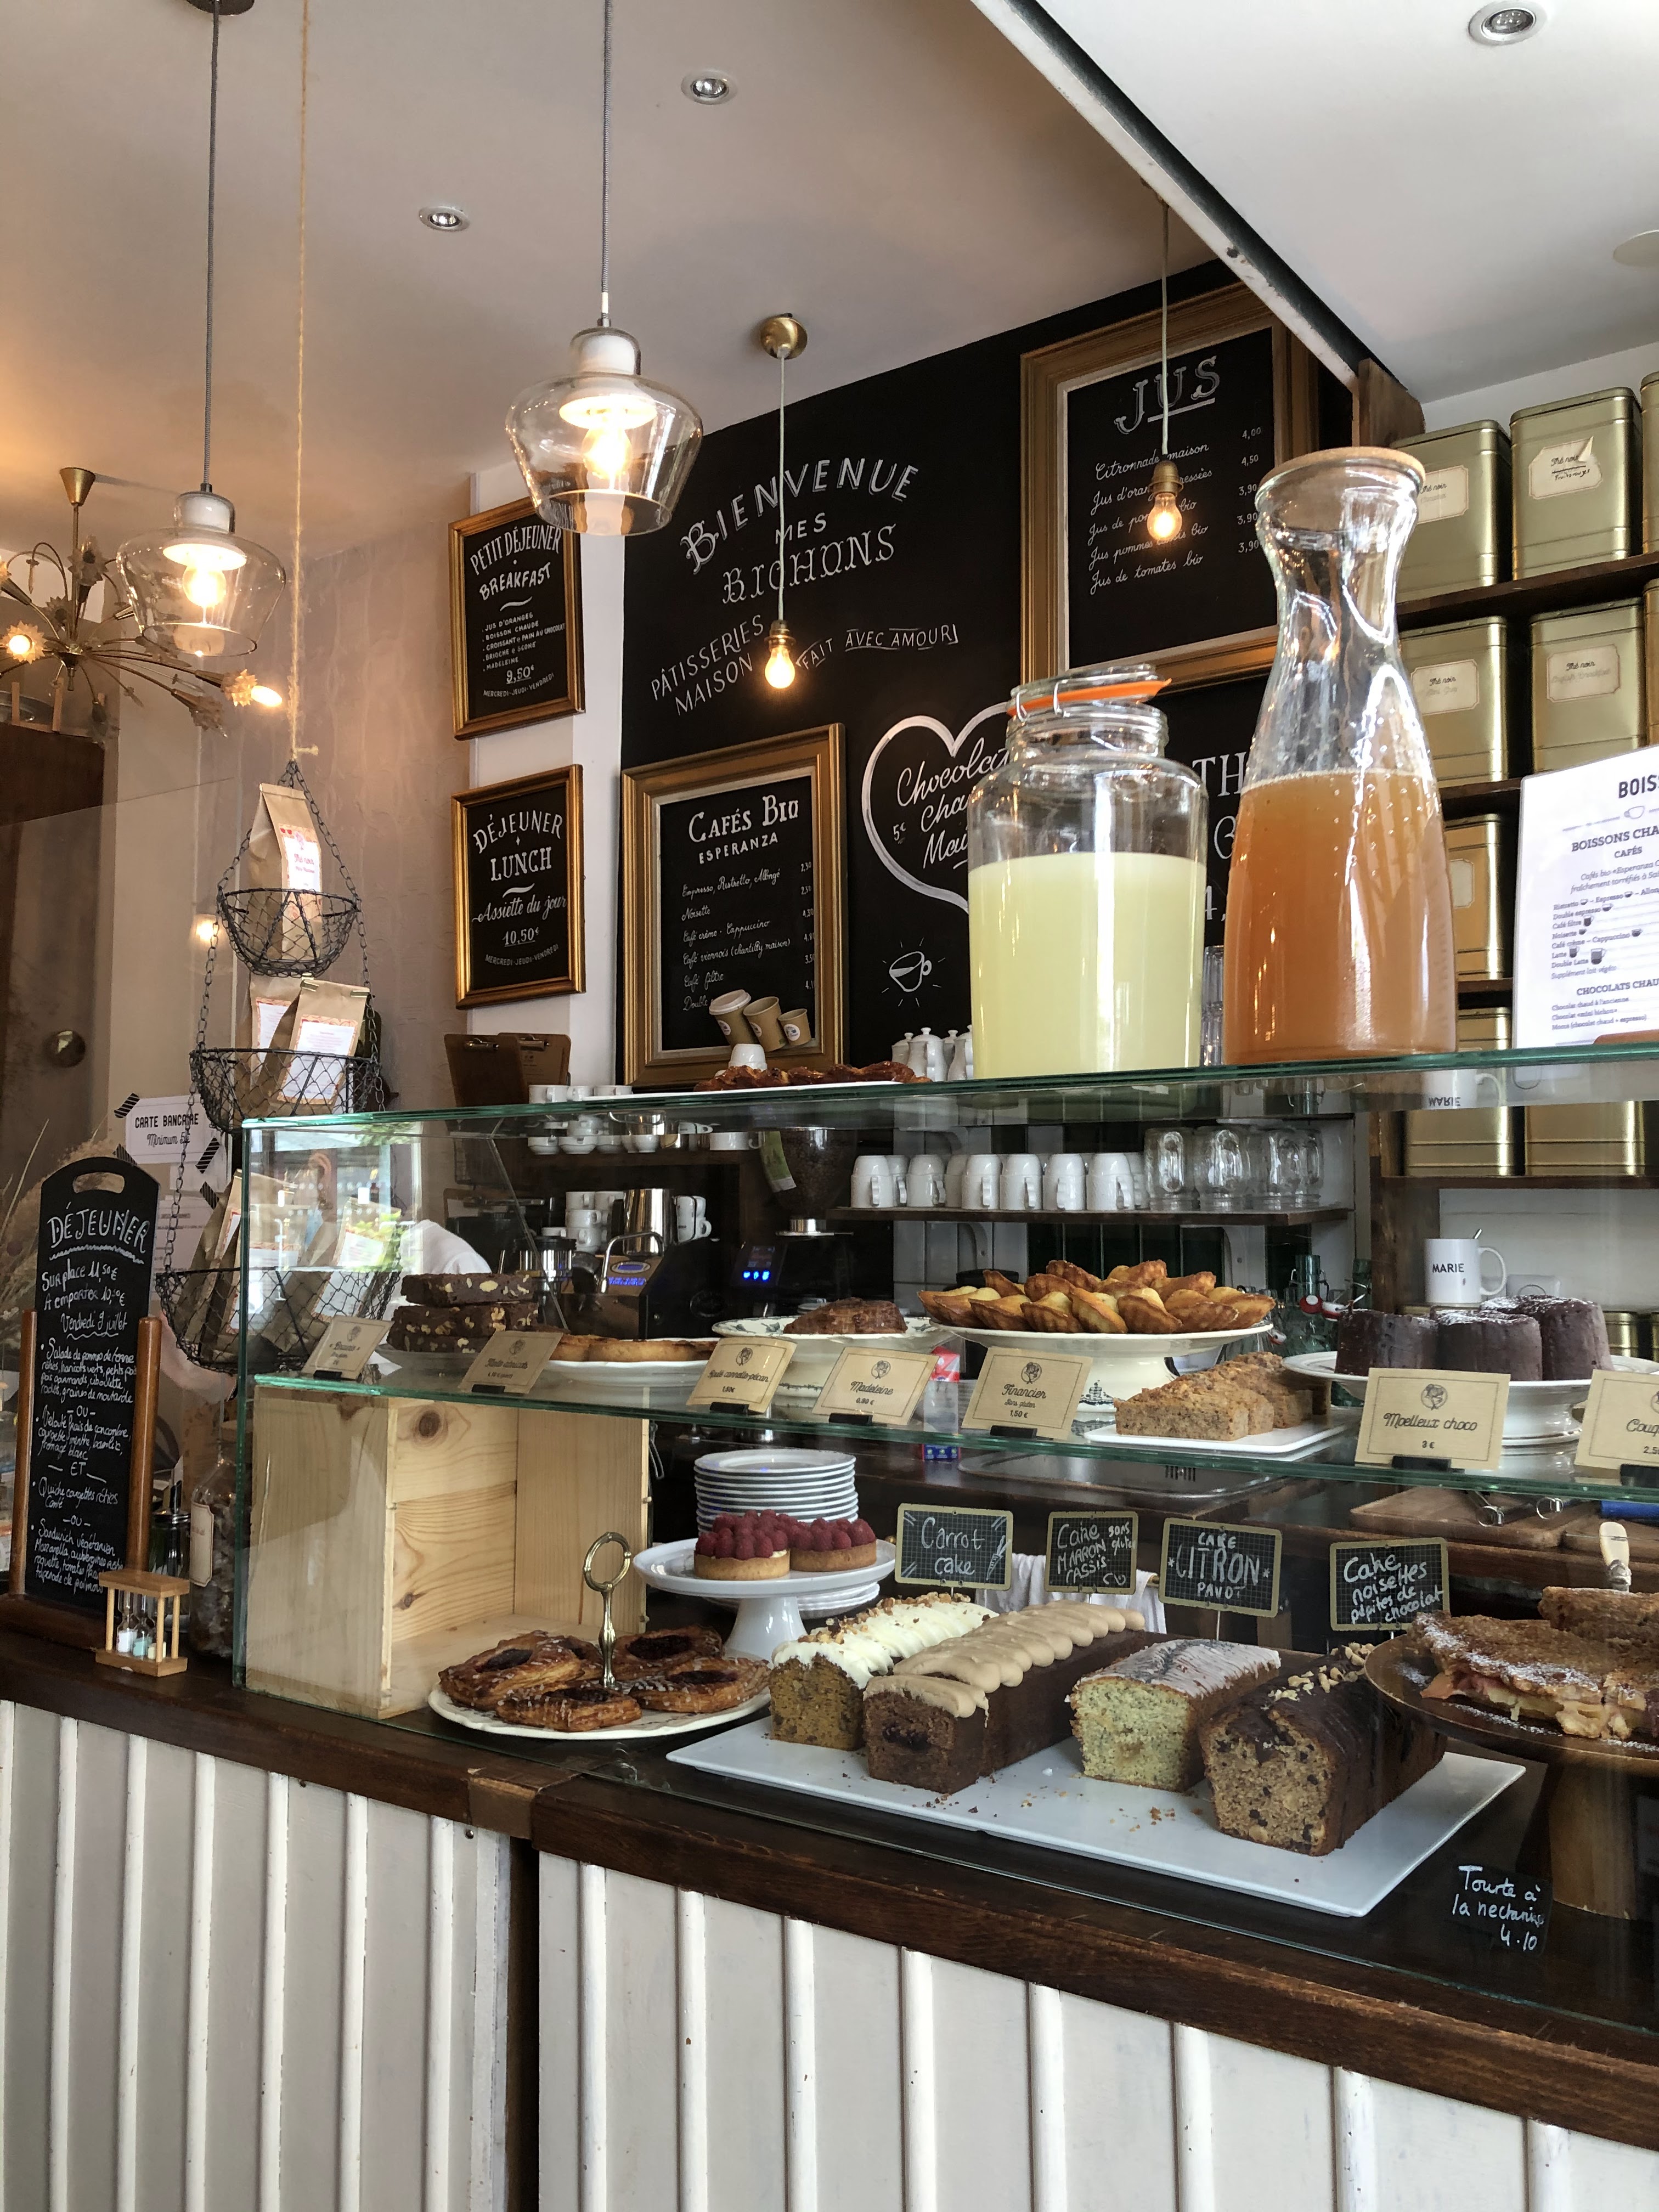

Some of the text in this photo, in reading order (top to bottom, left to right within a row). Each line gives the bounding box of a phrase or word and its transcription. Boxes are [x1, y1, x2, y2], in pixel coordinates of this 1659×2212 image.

[1114, 355, 1220, 435] JUS
[1096, 444, 1209, 481] Citronnade maison
[1241, 454, 1259, 466] 4,50
[680, 457, 918, 574] BIENVENUE
[1091, 490, 1111, 516] Jus
[774, 512, 827, 545] MES
[1087, 523, 1108, 546] Jus
[1111, 517, 1124, 530] de
[1180, 498, 1197, 512] bio
[470, 524, 562, 575] PETIT DÉJEUNER
[1089, 522, 1209, 572] Jus pommes bio
[722, 523, 896, 604] BICHONS
[1090, 550, 1203, 596] Jus de tomates bio
[479, 562, 551, 600] BREAKFAST
[485, 623, 496, 631] JUS
[486, 620, 539, 641] BOISSON CHAUDE
[486, 637, 516, 651] CROISSANT
[522, 632, 534, 641] PAIN
[544, 623, 566, 634] CHOCOLAT
[845, 631, 884, 647] AVEC
[486, 641, 536, 661] BRIOCHE SCONE
[486, 657, 518, 670] MADELEINE
[651, 614, 764, 701] PÂTISSERIES
[675, 653, 754, 715] MAISON
[473, 810, 563, 854] DÉJEUNER
[1571, 831, 1630, 852] BOISSONS
[699, 832, 778, 865] ESPERANZA
[1614, 845, 1643, 859] CAFÉS
[490, 847, 552, 882] LUNCH
[471, 894, 567, 922] Assiette du jour
[681, 905, 710, 921] Noisette
[726, 919, 770, 939] Cappuccino
[683, 995, 708, 1011] Double
[1577, 982, 1630, 996] CHOCOLATS
[135, 1116, 158, 1128] CARTE
[146, 1133, 178, 1148] Minimum
[47, 1201, 149, 1254] DÉJEUNER
[1432, 1263, 1465, 1273] MARIE
[850, 1380, 895, 1396] Madeleine
[1001, 1384, 1047, 1399] Financier
[1383, 1413, 1478, 1431] Moelleux choco
[70, 1462, 87, 1476] ET
[921, 1516, 985, 1550] Carrot
[1058, 1521, 1100, 1549] Cake
[1198, 1532, 1237, 1550] CAKE
[935, 1554, 975, 1576] cake
[1058, 1538, 1107, 1575] MARRON
[1344, 1553, 1401, 1584] Cake
[1352, 1561, 1427, 1606] noisettes
[1397, 1585, 1417, 1602] de
[1385, 1584, 1444, 1623] chocolat
[1458, 1865, 1541, 1902] Tourte à
[1452, 1893, 1470, 1916] la
[1500, 1923, 1538, 1952] 4.10
